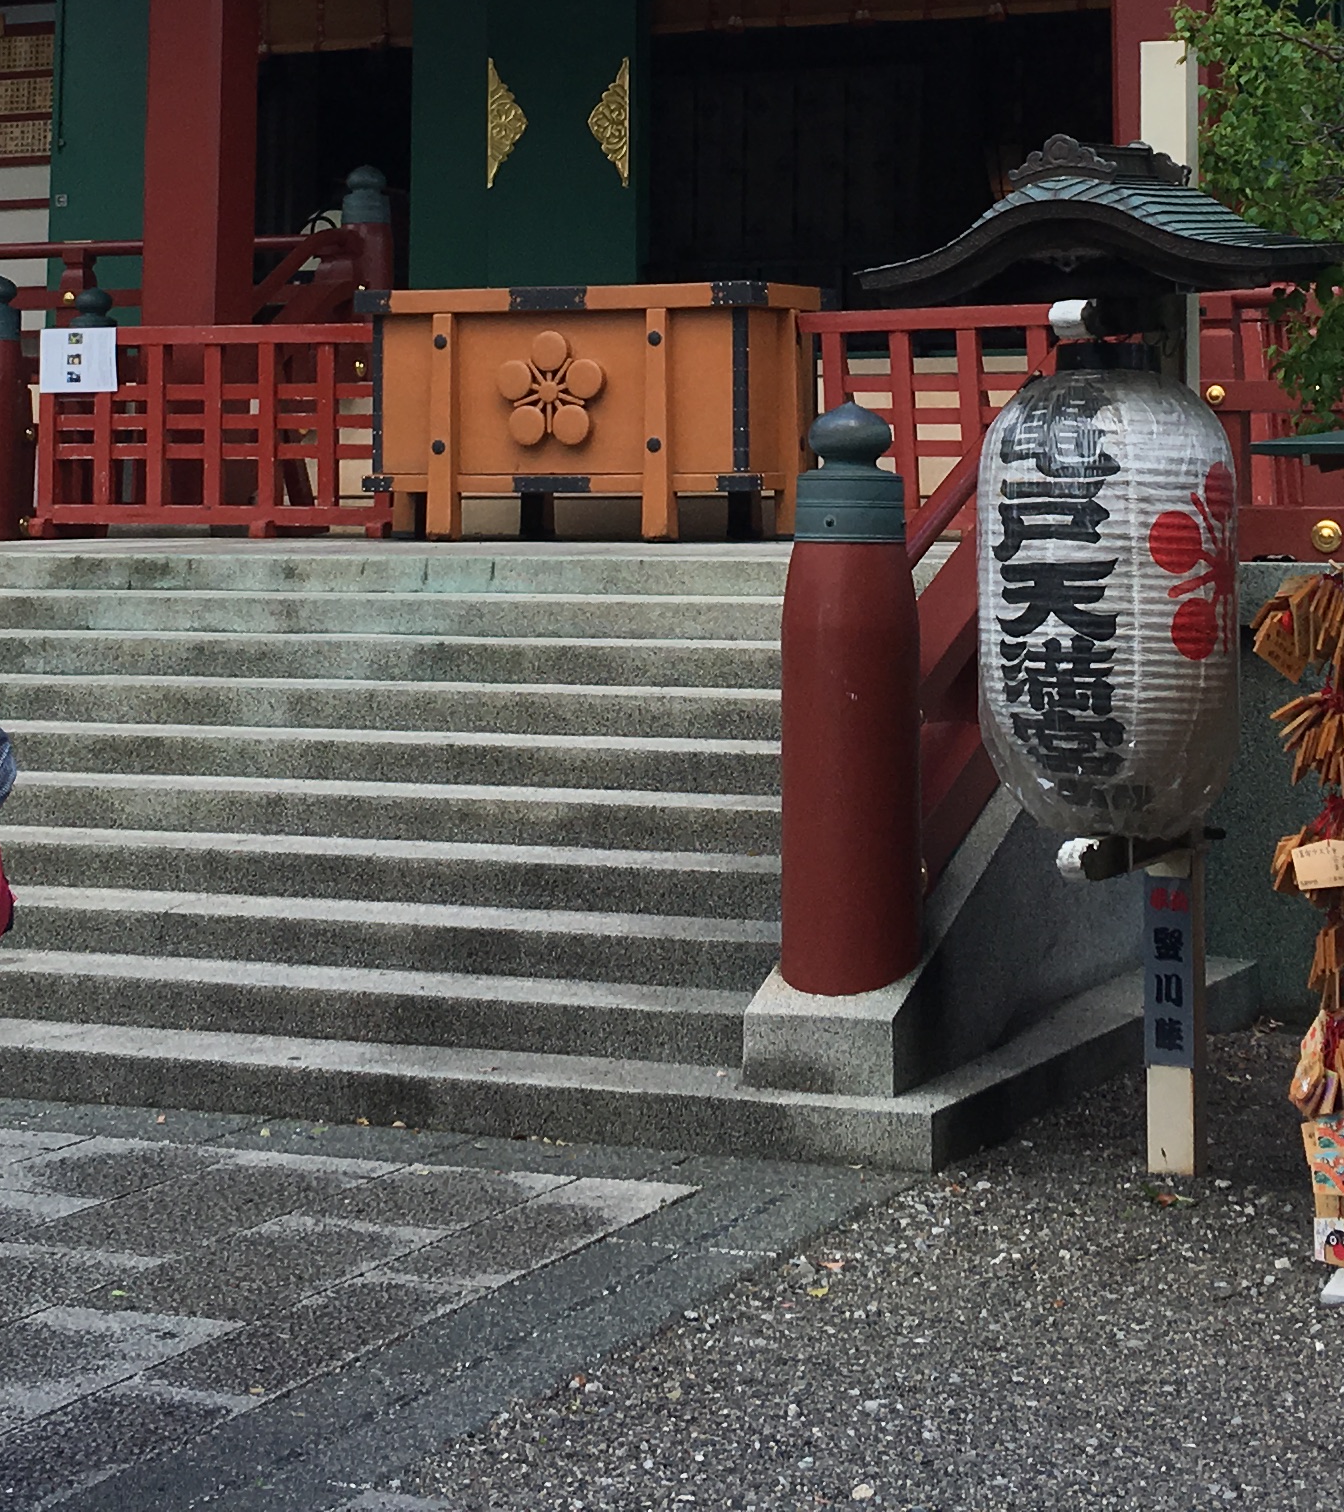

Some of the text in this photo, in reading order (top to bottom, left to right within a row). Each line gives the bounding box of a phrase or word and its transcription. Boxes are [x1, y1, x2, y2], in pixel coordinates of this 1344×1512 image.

[992, 378, 1126, 775] 亀戸天満宮
